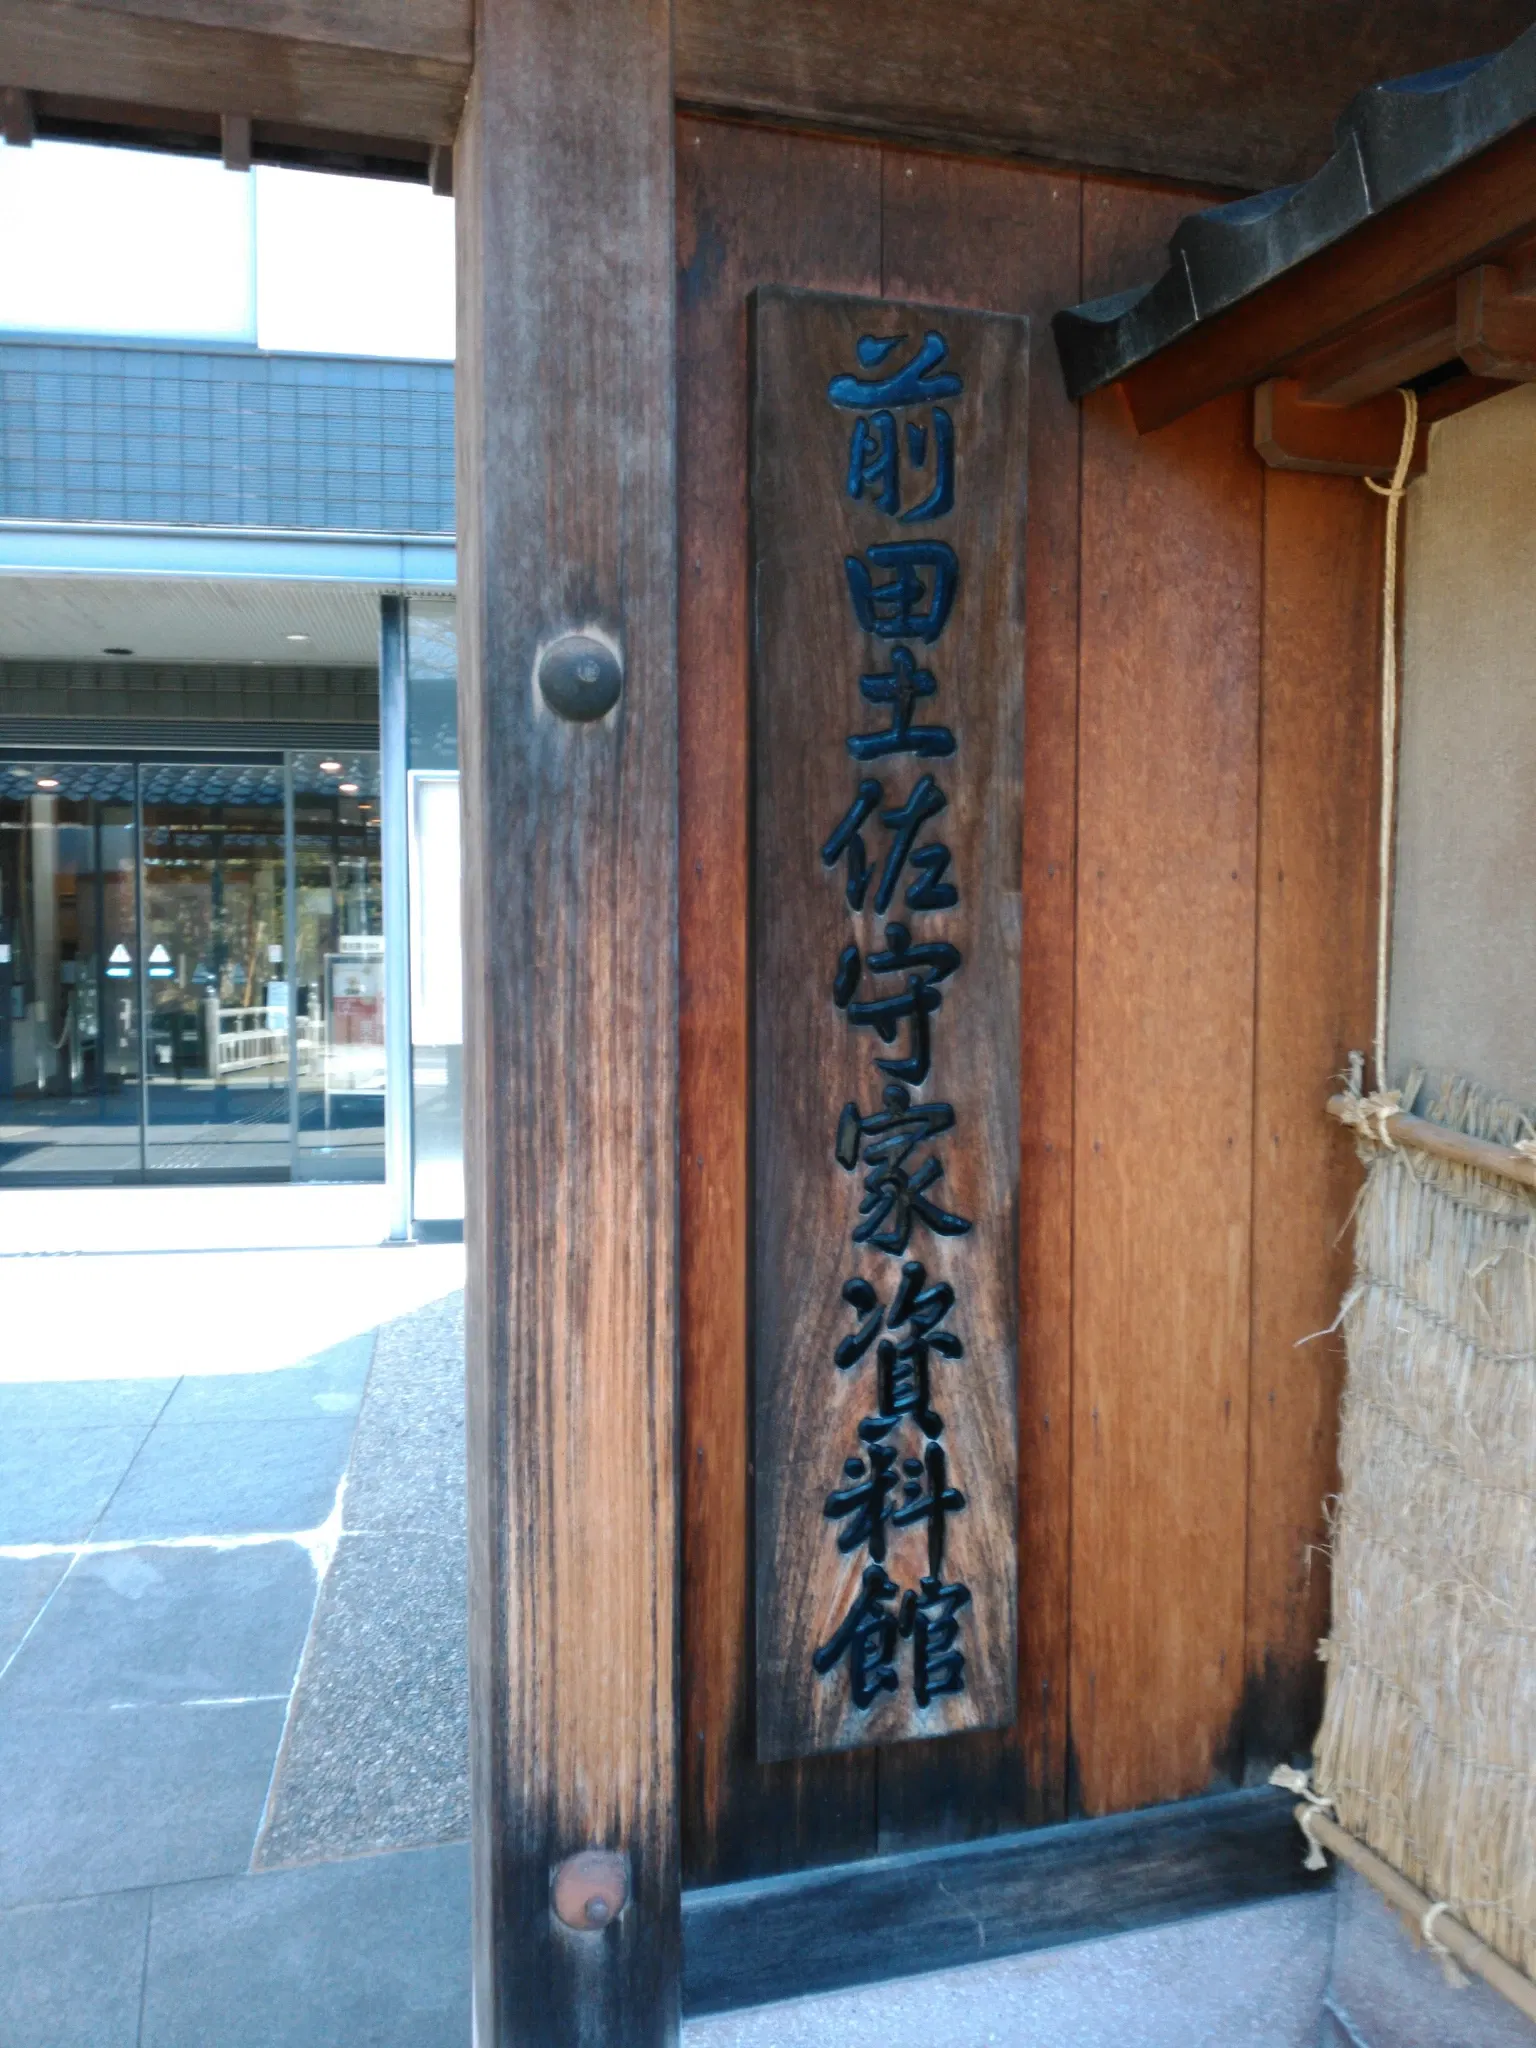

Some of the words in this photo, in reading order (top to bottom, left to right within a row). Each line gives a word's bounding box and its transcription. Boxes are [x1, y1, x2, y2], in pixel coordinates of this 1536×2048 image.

[812, 330, 972, 1710] 前田土佐守家資料館
